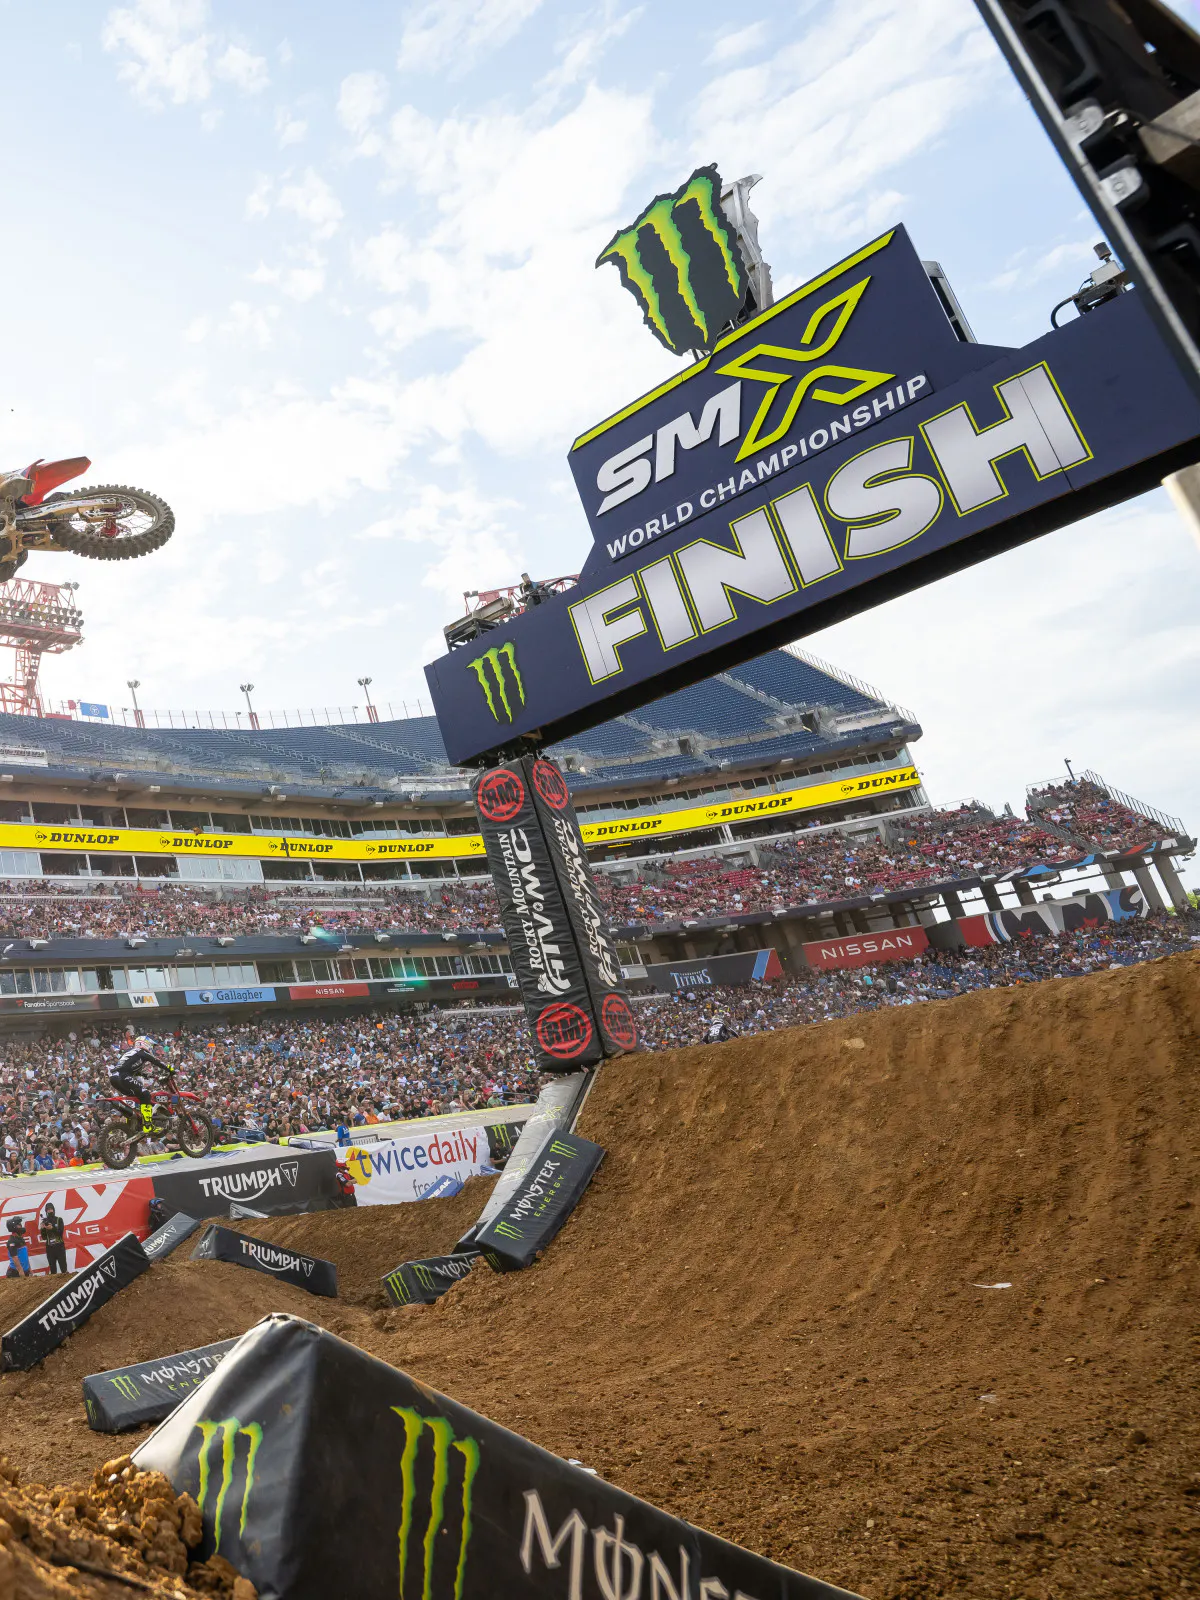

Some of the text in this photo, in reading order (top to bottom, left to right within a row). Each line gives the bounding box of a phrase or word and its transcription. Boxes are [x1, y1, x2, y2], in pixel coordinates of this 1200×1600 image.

[596, 277, 895, 516] SMX
[606, 374, 928, 560] WORLD CHAMPIONSHIP
[569, 361, 1094, 685] FINISH
[720, 797, 792, 818] DUNLOP
[49, 832, 119, 844] DUNLOP
[596, 820, 662, 836] DUNLOP
[172, 838, 233, 849] DUNLOP
[280, 842, 333, 853] DUNLOP
[378, 843, 434, 853] DUNLOP
[552, 816, 600, 957] ROCKY MOUNTAIN
[497, 832, 545, 971] ROCKY MOUNTAIN
[820, 934, 913, 961] NISSAN
[315, 987, 345, 995] NISSAN
[670, 969, 712, 989] TITANS
[133, 995, 155, 1004] WM
[216, 989, 263, 1002] Gallagher
[356, 1130, 478, 1178] twicedaily
[198, 1167, 282, 1199] TRIUMPH
[534, 1175, 564, 1217] ENERGY
[239, 1239, 301, 1272] TRIUMPH
[38, 1270, 106, 1332] TRIUMPH
[140, 1352, 230, 1385] MONSTE
[168, 1375, 207, 1391] ENE
